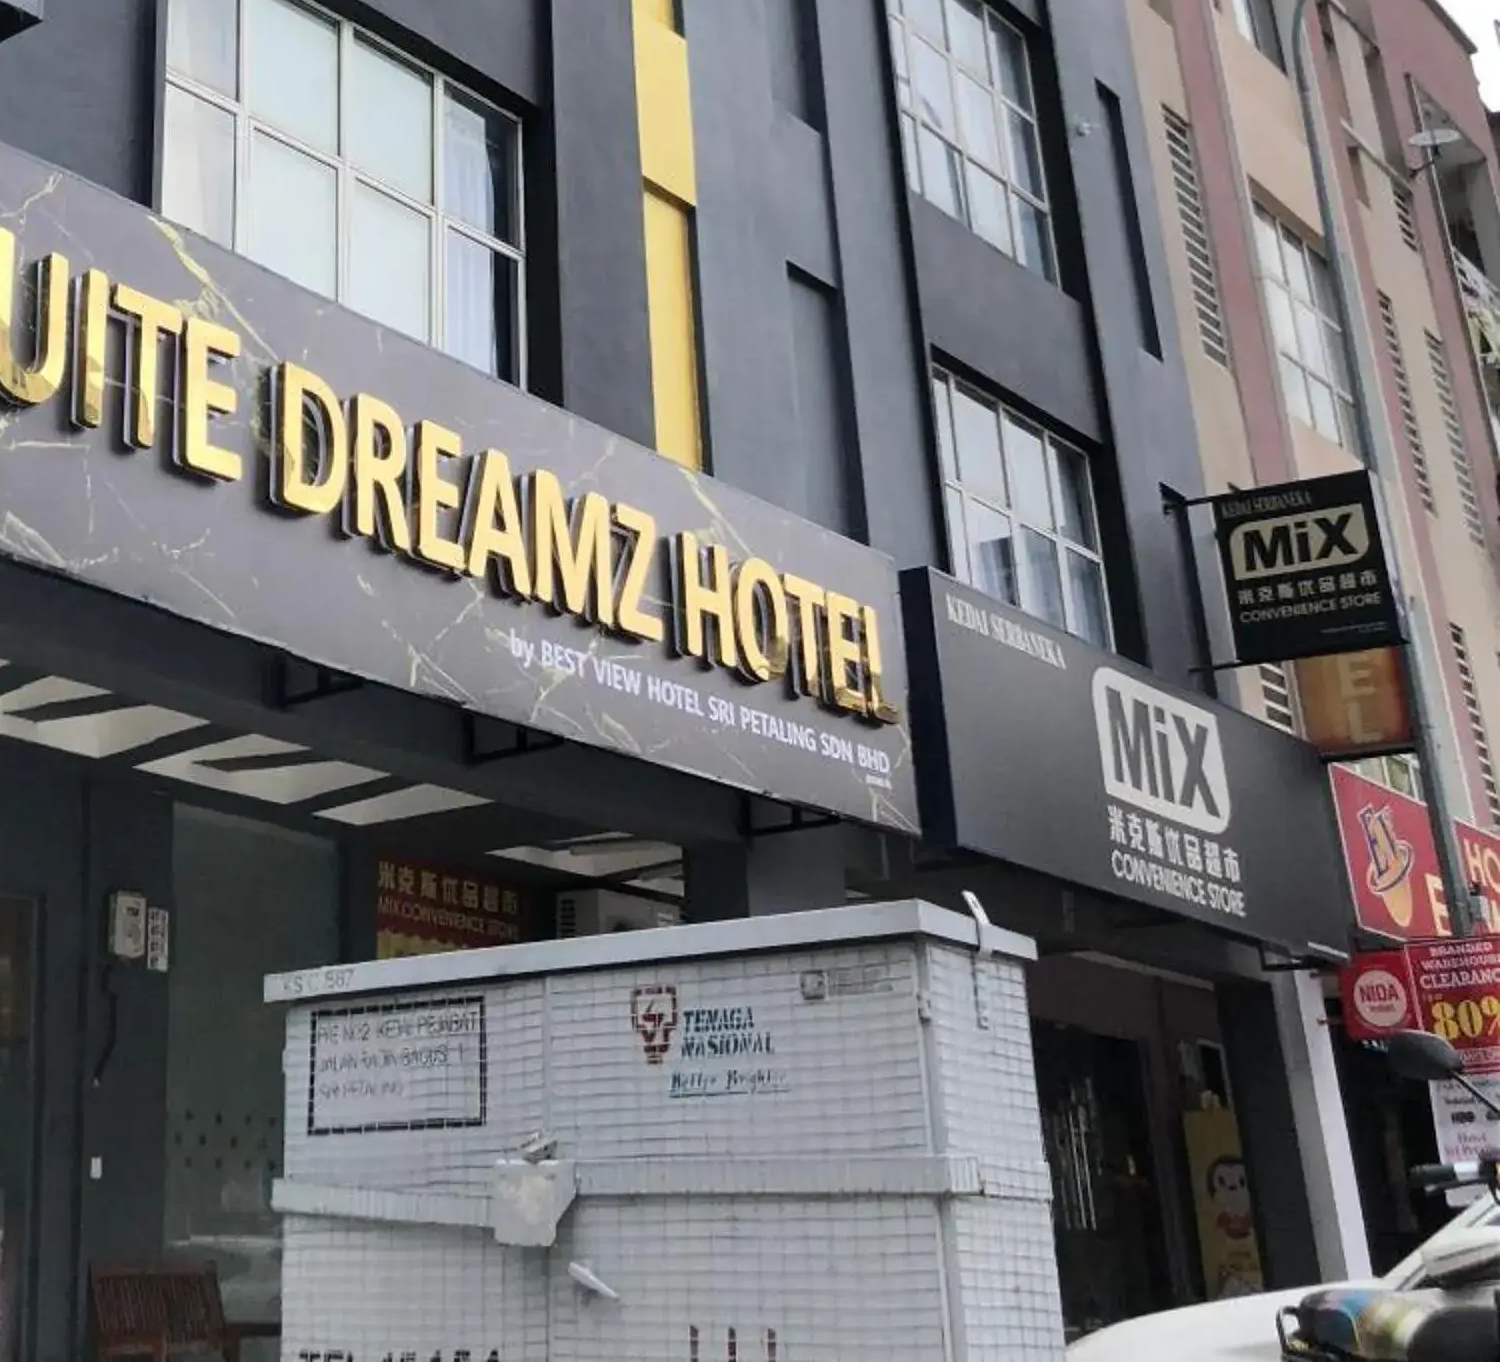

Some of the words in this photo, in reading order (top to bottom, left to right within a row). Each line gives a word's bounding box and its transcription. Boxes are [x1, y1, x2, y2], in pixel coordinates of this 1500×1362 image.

[272, 361, 664, 643] DREAMZ
[672, 531, 900, 725] HOTEL
[1243, 512, 1358, 572] MiX
[1240, 598, 1337, 623] CONVENIENCE
[1340, 591, 1381, 611] STORE
[511, 628, 534, 668] by
[541, 642, 587, 680] BEST
[593, 660, 641, 697] VIEW
[647, 675, 704, 717] HOTEL
[708, 696, 736, 727] SRI
[741, 706, 817, 752] PETALING
[820, 731, 854, 764] SDN
[857, 743, 891, 774] BHD
[1105, 685, 1221, 819] MiX
[1111, 849, 1206, 906] CONVENIENCE
[1208, 882, 1247, 917] STORE
[1429, 941, 1493, 957] BRANDED
[1359, 983, 1399, 1004] NIDA
[683, 1006, 755, 1033] TENAGA
[681, 1032, 775, 1059] NASIONAL
